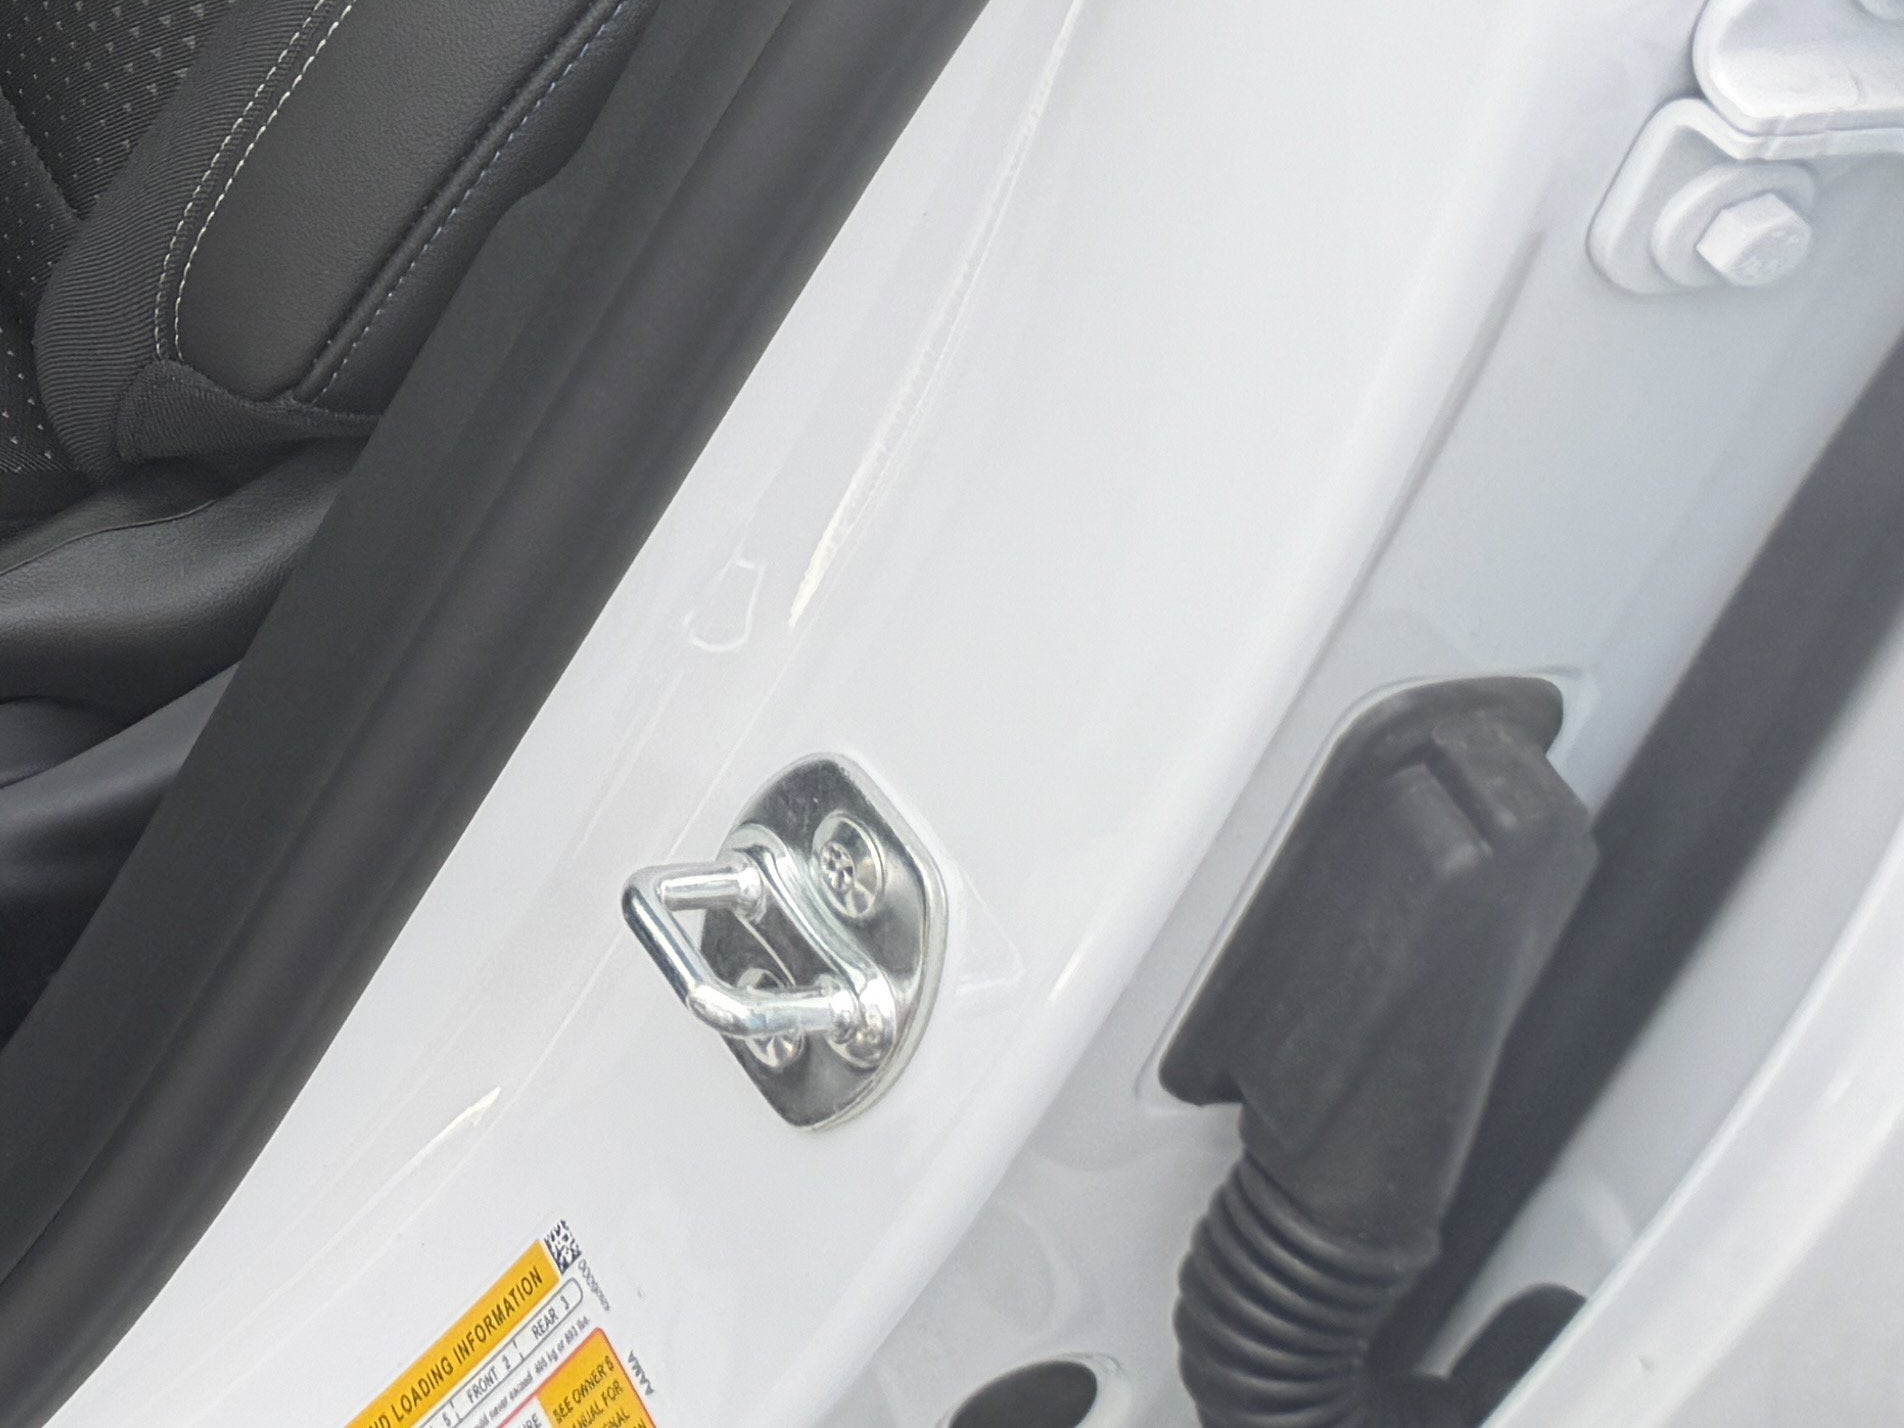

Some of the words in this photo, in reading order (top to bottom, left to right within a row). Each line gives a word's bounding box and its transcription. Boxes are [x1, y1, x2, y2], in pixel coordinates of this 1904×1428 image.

[391, 1356, 454, 1422] LOADING
[453, 1265, 543, 1365] INFORMATION
[466, 1366, 499, 1404] FRONT
[502, 1355, 511, 1371] 2
[531, 1308, 559, 1340] REAR
[552, 1396, 574, 1425] SEE
[572, 1355, 614, 1404] OWNER'S
[601, 1380, 623, 1408] FOR
